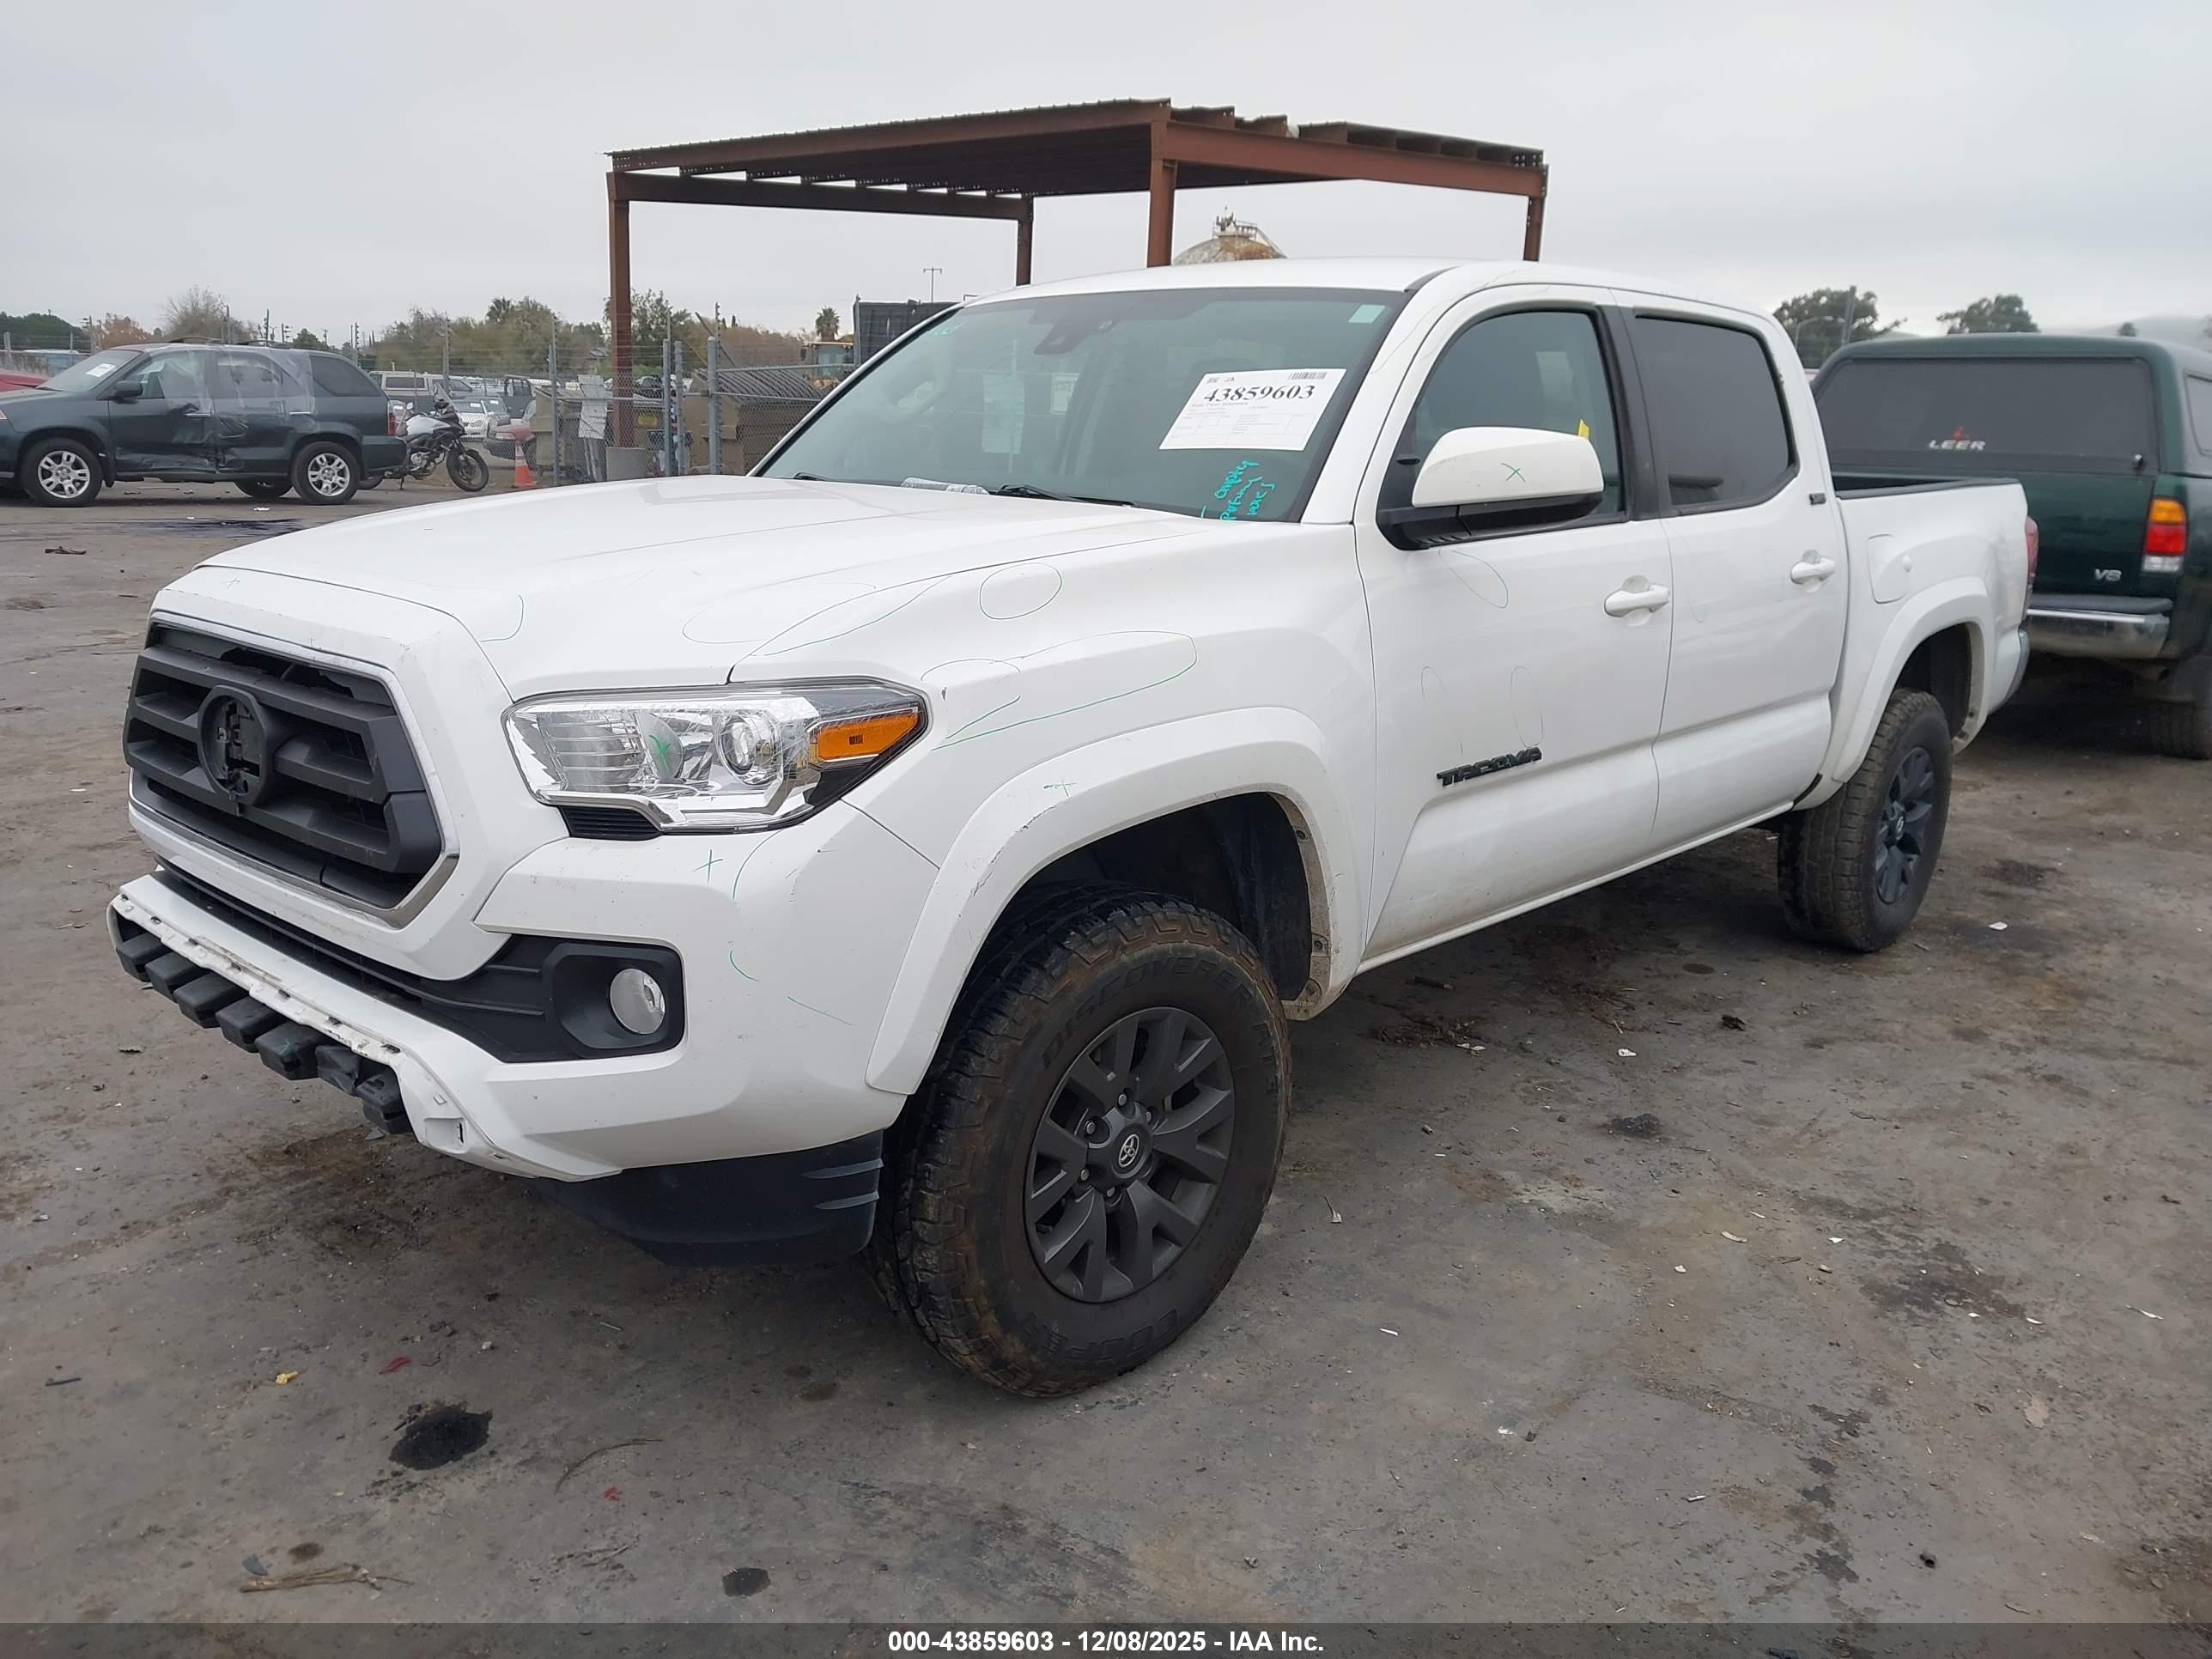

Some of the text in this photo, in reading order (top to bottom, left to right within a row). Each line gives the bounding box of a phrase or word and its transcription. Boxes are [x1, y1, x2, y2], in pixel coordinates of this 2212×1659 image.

[1204, 385, 1316, 403] 43859603
[1929, 439, 1986, 451] LEER
[1437, 746, 1542, 787] TACOMA
